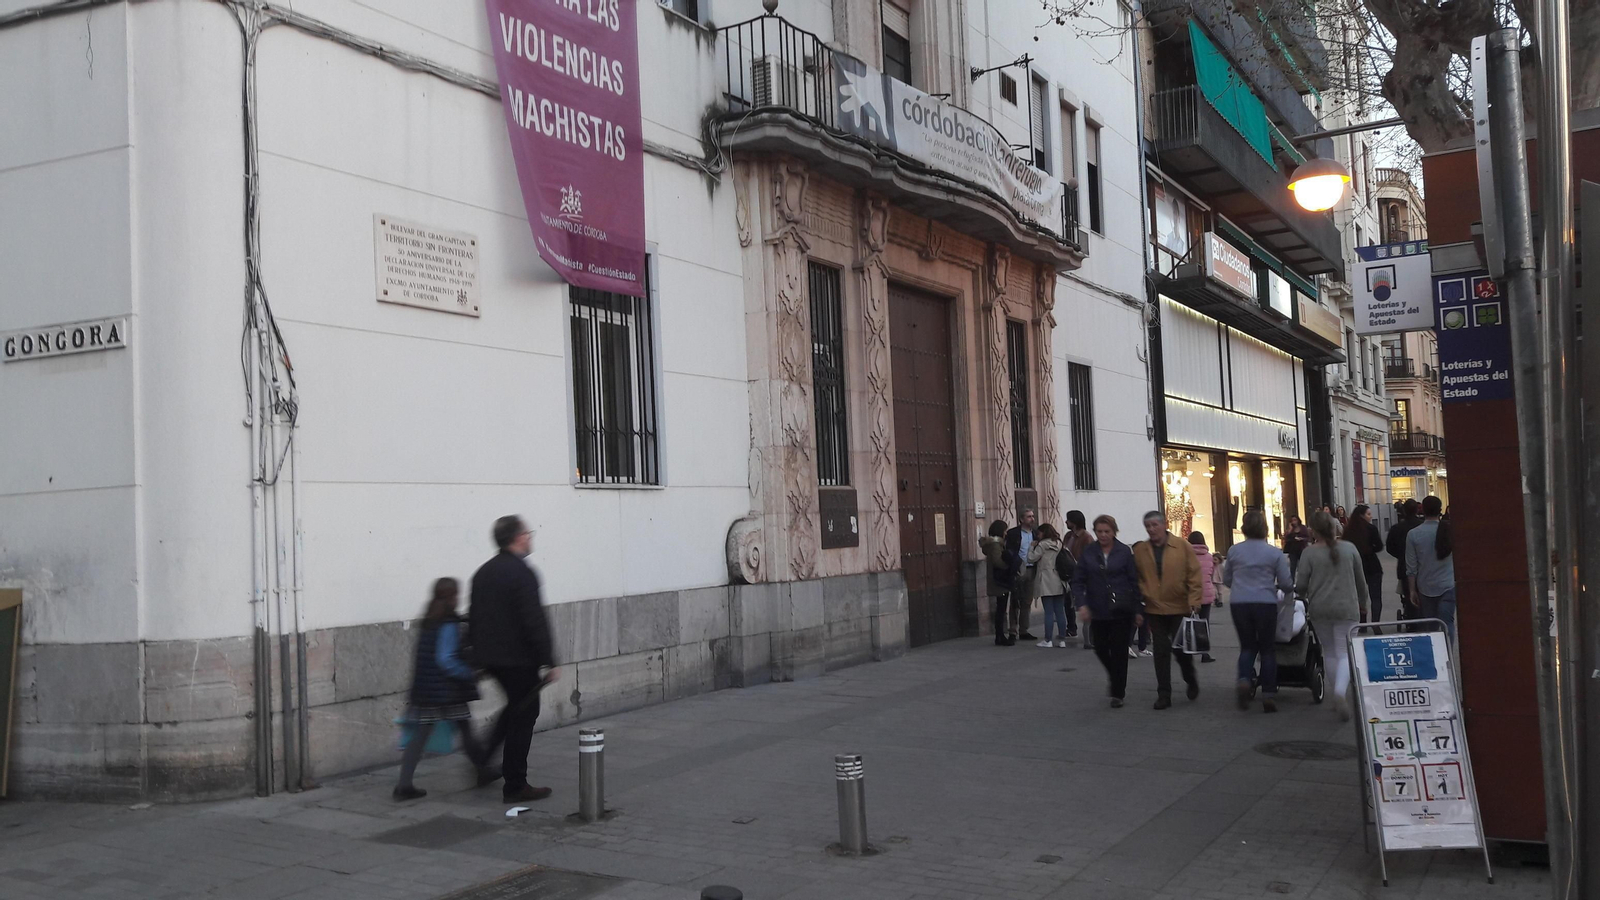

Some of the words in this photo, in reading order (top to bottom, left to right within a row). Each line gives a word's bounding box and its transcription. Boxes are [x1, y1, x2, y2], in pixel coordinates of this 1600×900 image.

[500, 13, 623, 96] VIOLENCIAS
[508, 84, 626, 161] MACHISTAS
[417, 230, 426, 238] DEL
[428, 231, 443, 242] GRAN
[386, 233, 423, 248] TERRITORIO
[425, 242, 436, 251] SIN
[438, 245, 474, 260] FRONTERAS
[407, 250, 444, 263] ANIVERSARIO
[446, 258, 452, 266] DE
[454, 260, 462, 268] LA
[1220, 242, 1250, 279] Ciudadanos
[387, 265, 417, 277] DERECHOS
[419, 272, 447, 282] HUMANOS
[425, 262, 455, 276] UNIVERSAL
[465, 271, 475, 279] LOS
[409, 283, 454, 296] AYUNTAMIENTO
[1368, 300, 1399, 310] Loterías
[1402, 300, 1407, 308] y
[1369, 310, 1405, 319] Apuestas
[1407, 306, 1419, 315] del
[1369, 318, 1396, 327] Estado
[5, 323, 121, 357] GONGORA
[1442, 359, 1483, 371] Loterías
[1486, 359, 1492, 369] y
[1443, 371, 1489, 386] Apuestas
[1493, 370, 1508, 380] del
[1443, 387, 1478, 398] Estado
[1389, 689, 1426, 706] BOTES
[1385, 737, 1405, 749] 16
[1432, 736, 1450, 749] 17
[1395, 782, 1406, 794] 7
